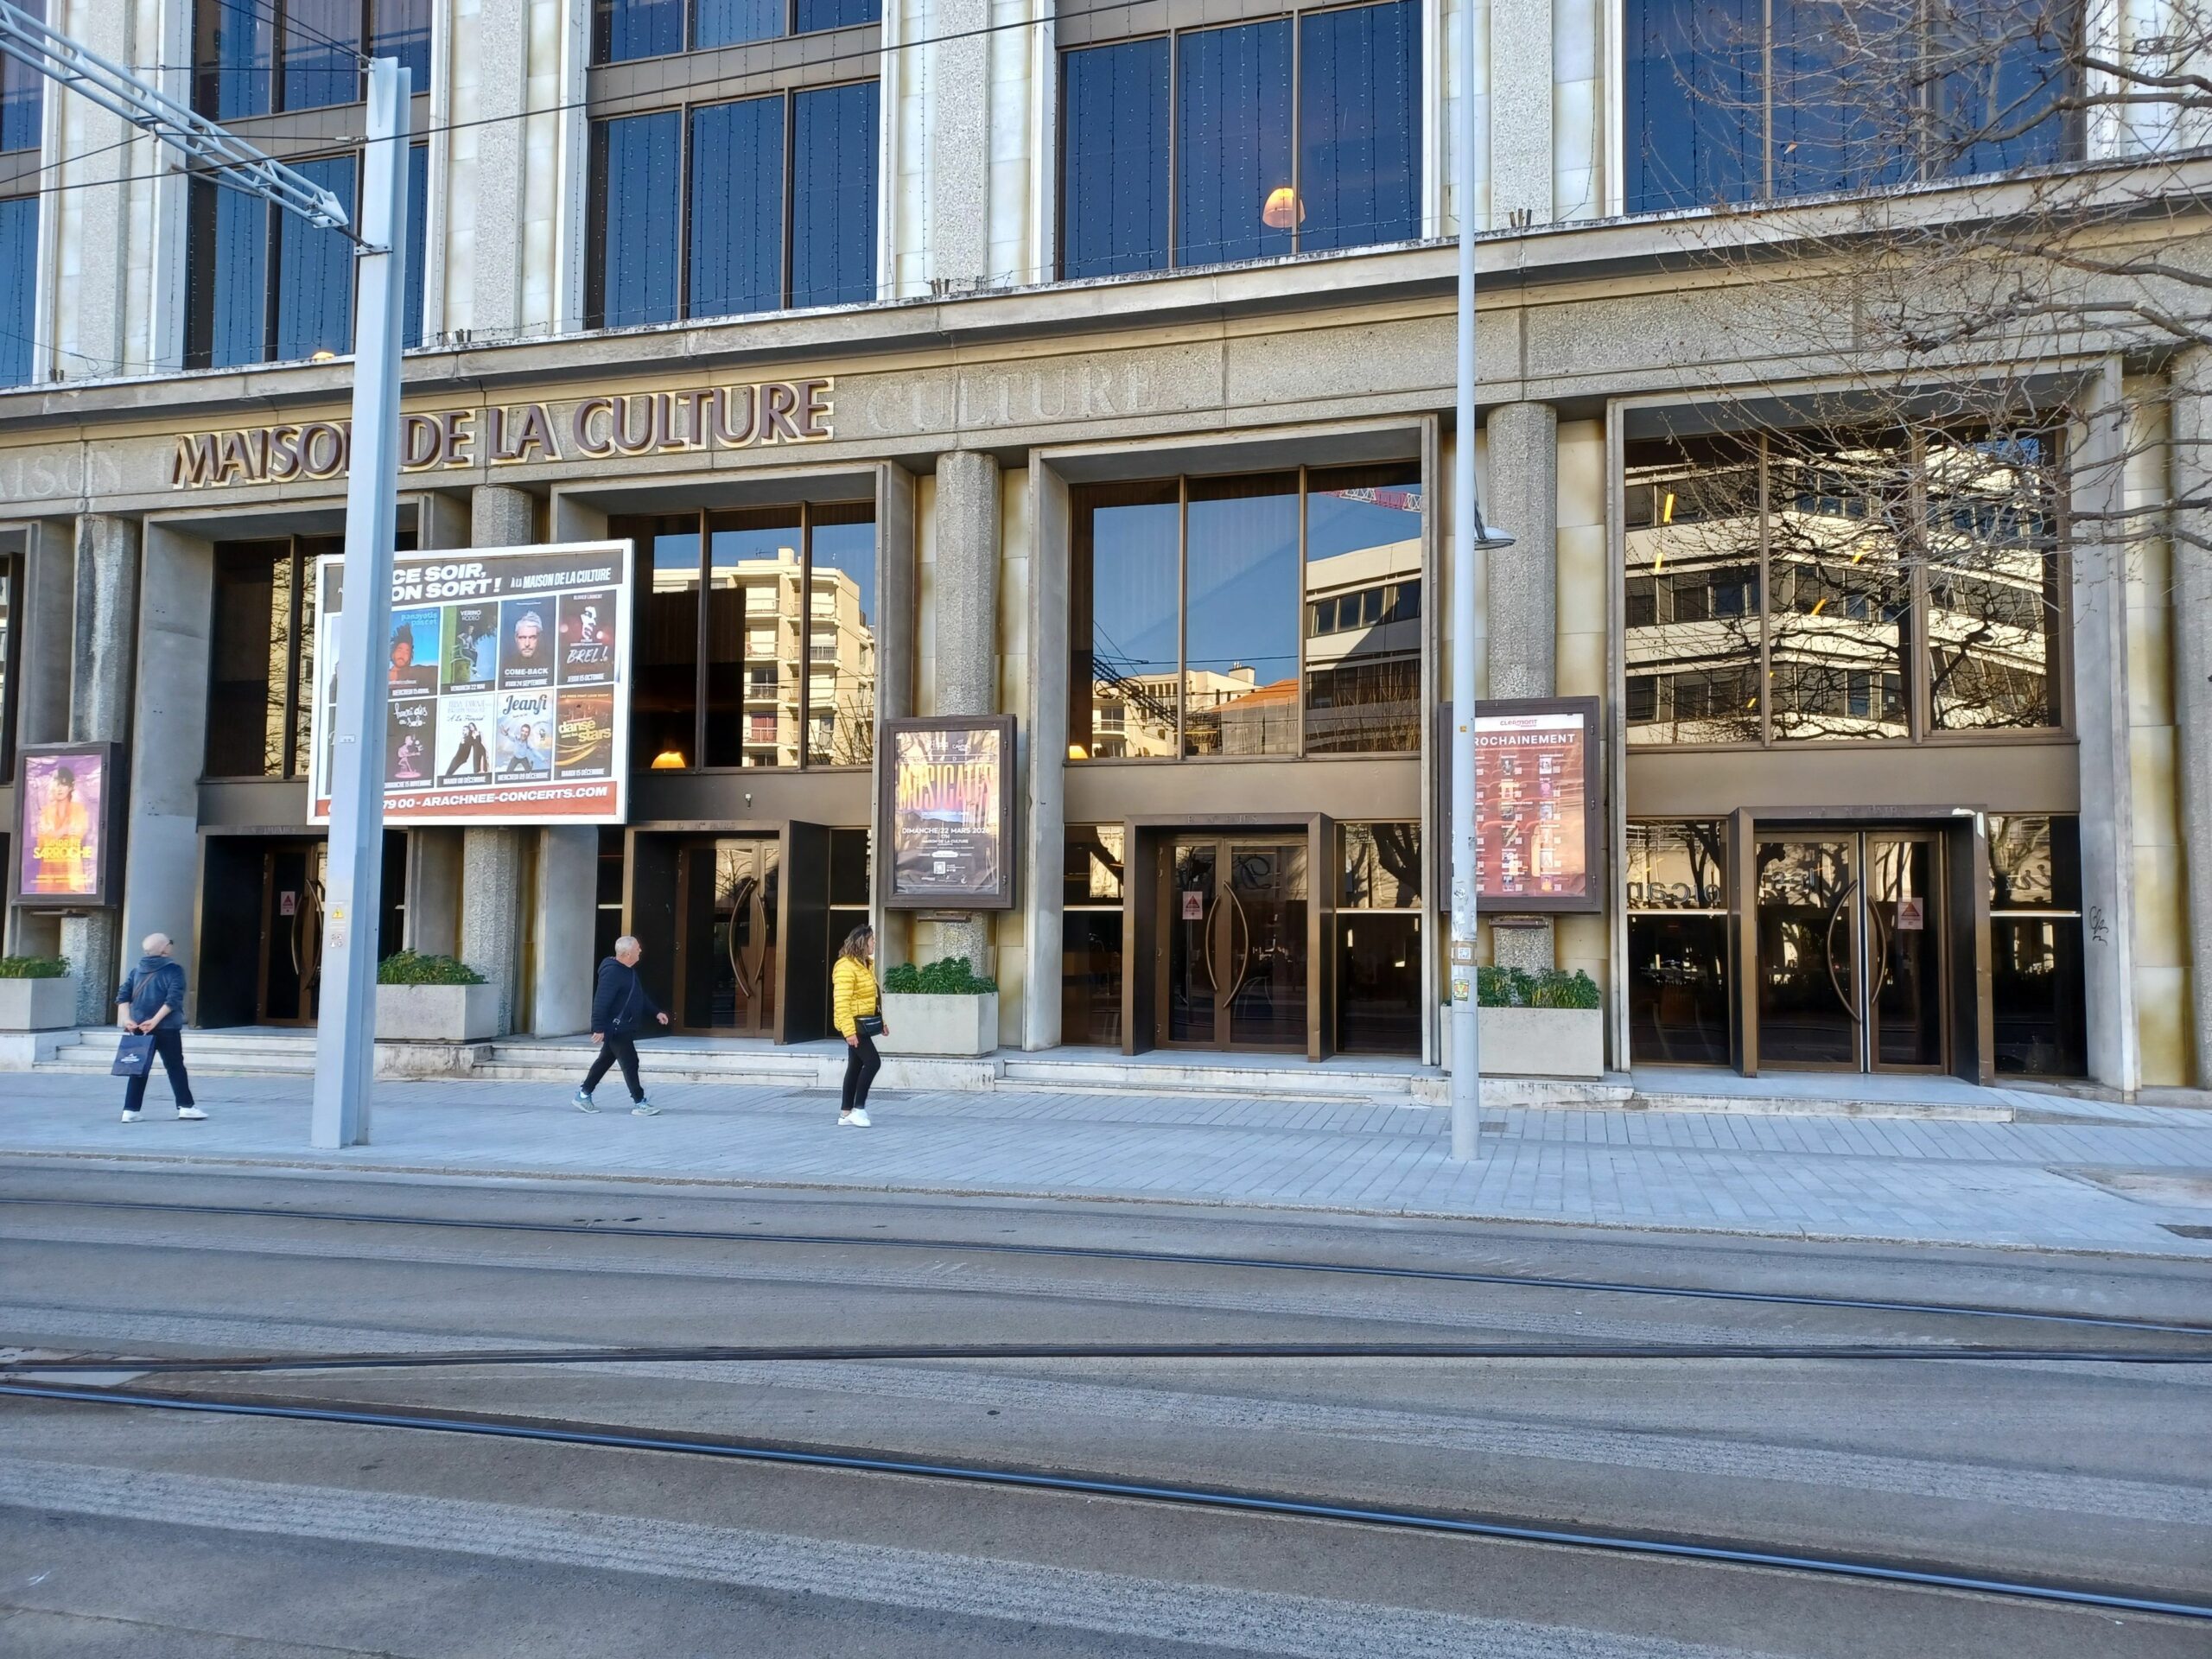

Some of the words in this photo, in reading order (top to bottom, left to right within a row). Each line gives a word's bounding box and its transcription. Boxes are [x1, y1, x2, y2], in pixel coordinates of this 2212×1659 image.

[413, 410, 475, 474] DE
[487, 403, 563, 467] LA
[572, 378, 836, 457] CULTURE
[392, 568, 421, 585] CE
[424, 563, 486, 582] SOIR,
[523, 572, 554, 588] MAISON
[554, 572, 565, 586] DE
[565, 571, 575, 585] LA
[576, 567, 612, 583] CULTURE
[391, 584, 423, 602] ON
[425, 578, 493, 599] SORT
[504, 667, 549, 676] COME-BACK
[502, 694, 547, 715] Jeanfi
[558, 719, 596, 734] danse
[578, 728, 611, 742] stars
[1475, 734, 1576, 746] ROCHAINEMENT
[398, 798, 415, 809] 00
[421, 786, 609, 807] ARACHNEE-CONCERTS.COM
[32, 846, 93, 859] SARROCHE
